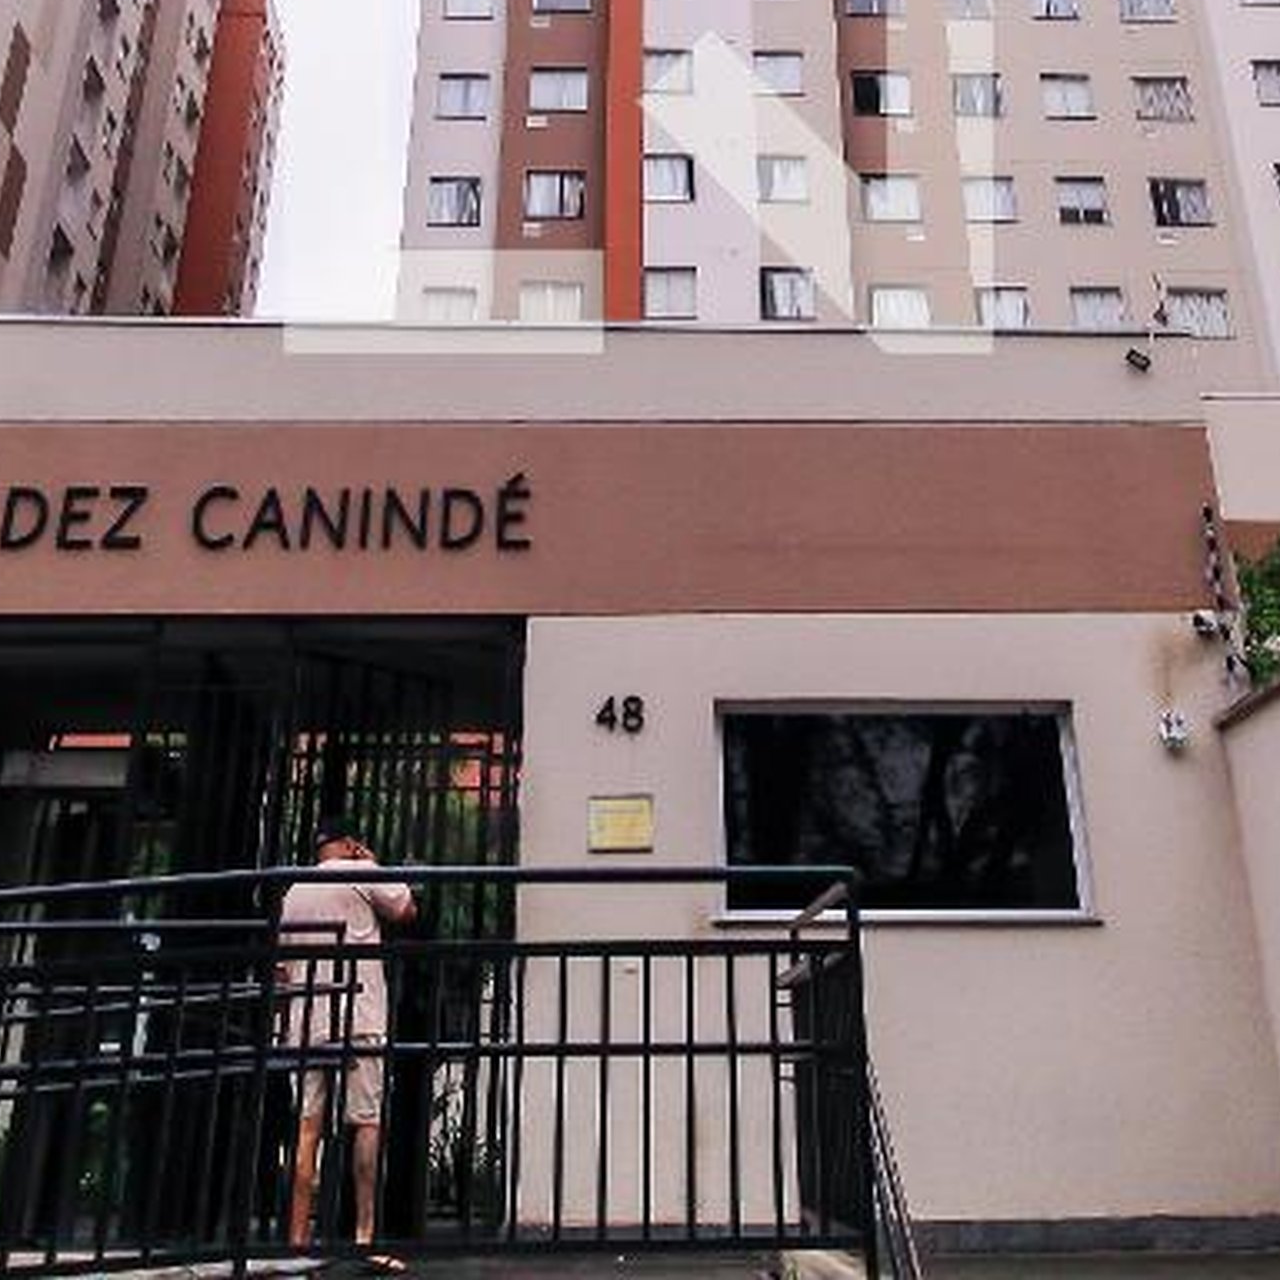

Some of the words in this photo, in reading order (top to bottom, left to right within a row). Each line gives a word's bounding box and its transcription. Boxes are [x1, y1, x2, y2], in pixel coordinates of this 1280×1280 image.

[0, 487, 150, 552] DEZ
[191, 473, 532, 553] CANINDÉ
[595, 695, 645, 734] 48
